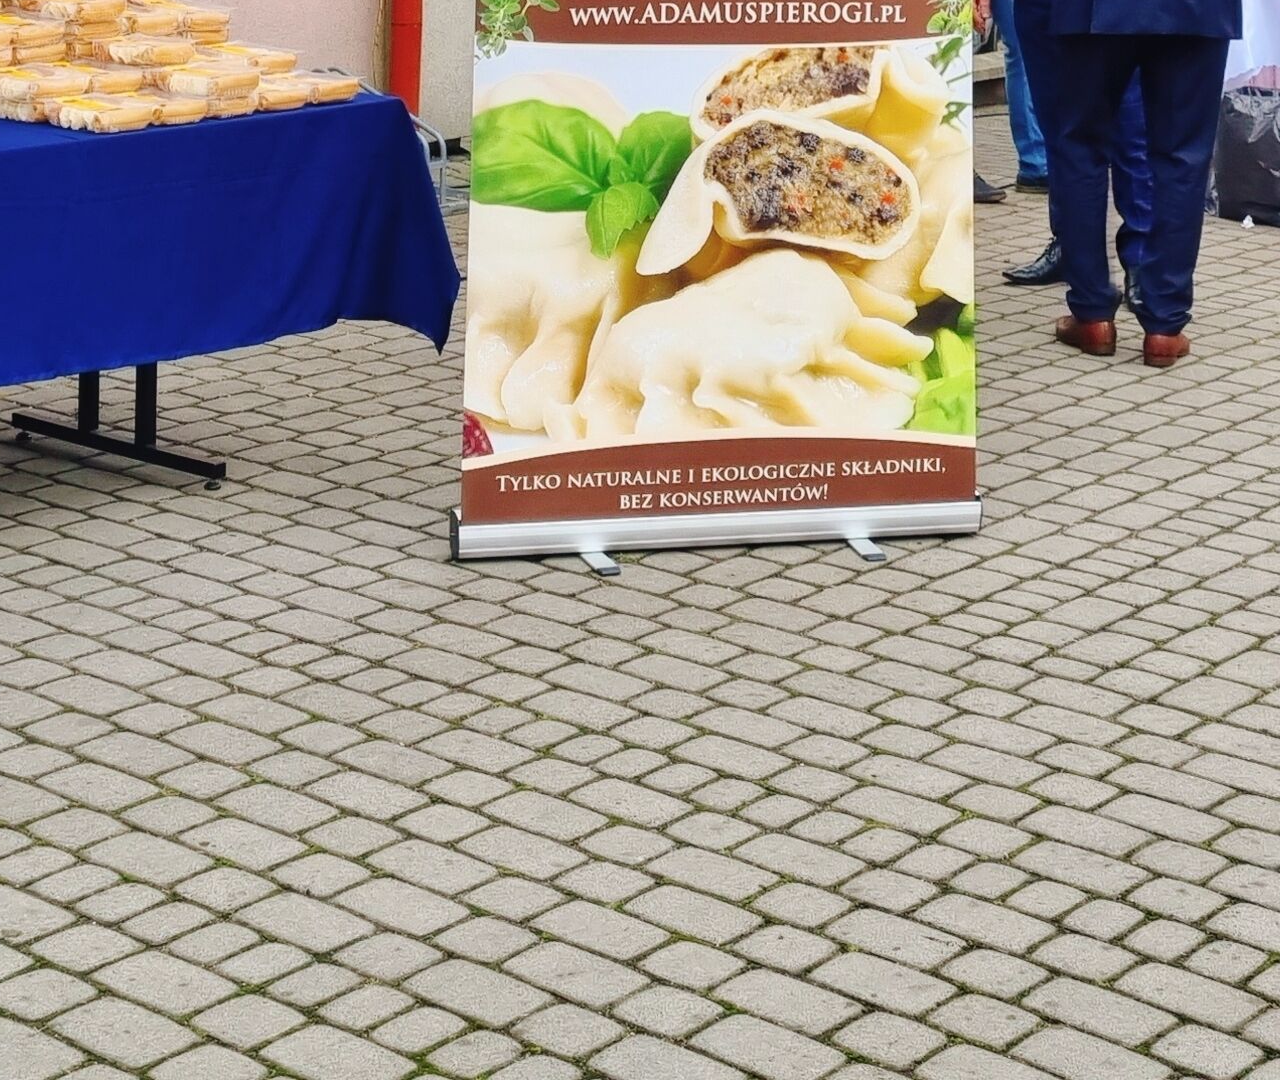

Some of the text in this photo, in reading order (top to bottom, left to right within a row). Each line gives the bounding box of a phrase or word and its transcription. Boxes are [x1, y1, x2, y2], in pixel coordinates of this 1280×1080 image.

[495, 456, 947, 493] TYLKO NATURALNE I EKOLOGICZNE SKŁADNIKI,
[619, 483, 829, 510] BEZ KONSERWANTÓW!
